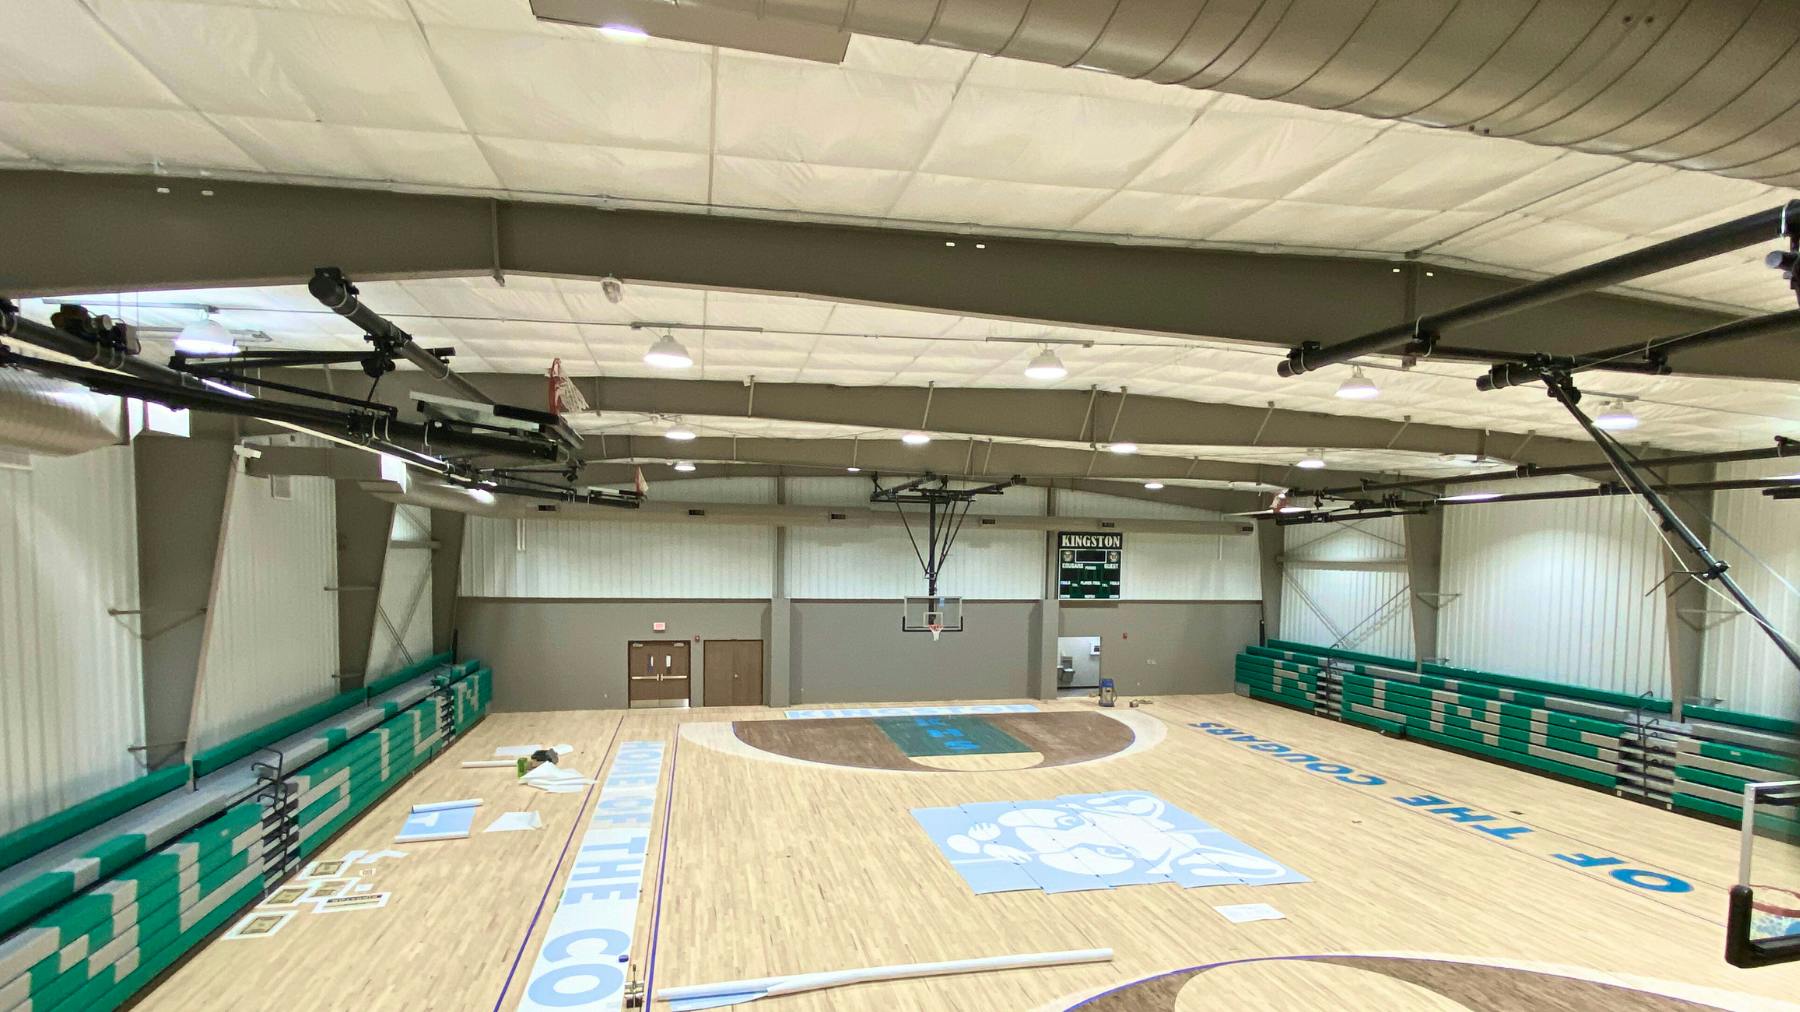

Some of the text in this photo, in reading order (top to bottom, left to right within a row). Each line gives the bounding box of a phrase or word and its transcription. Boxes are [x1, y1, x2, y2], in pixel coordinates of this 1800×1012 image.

[1061, 535, 1120, 547] KINGSTON
[1187, 721, 1694, 893] OF THE COUGARS
[563, 836, 648, 906] THE
